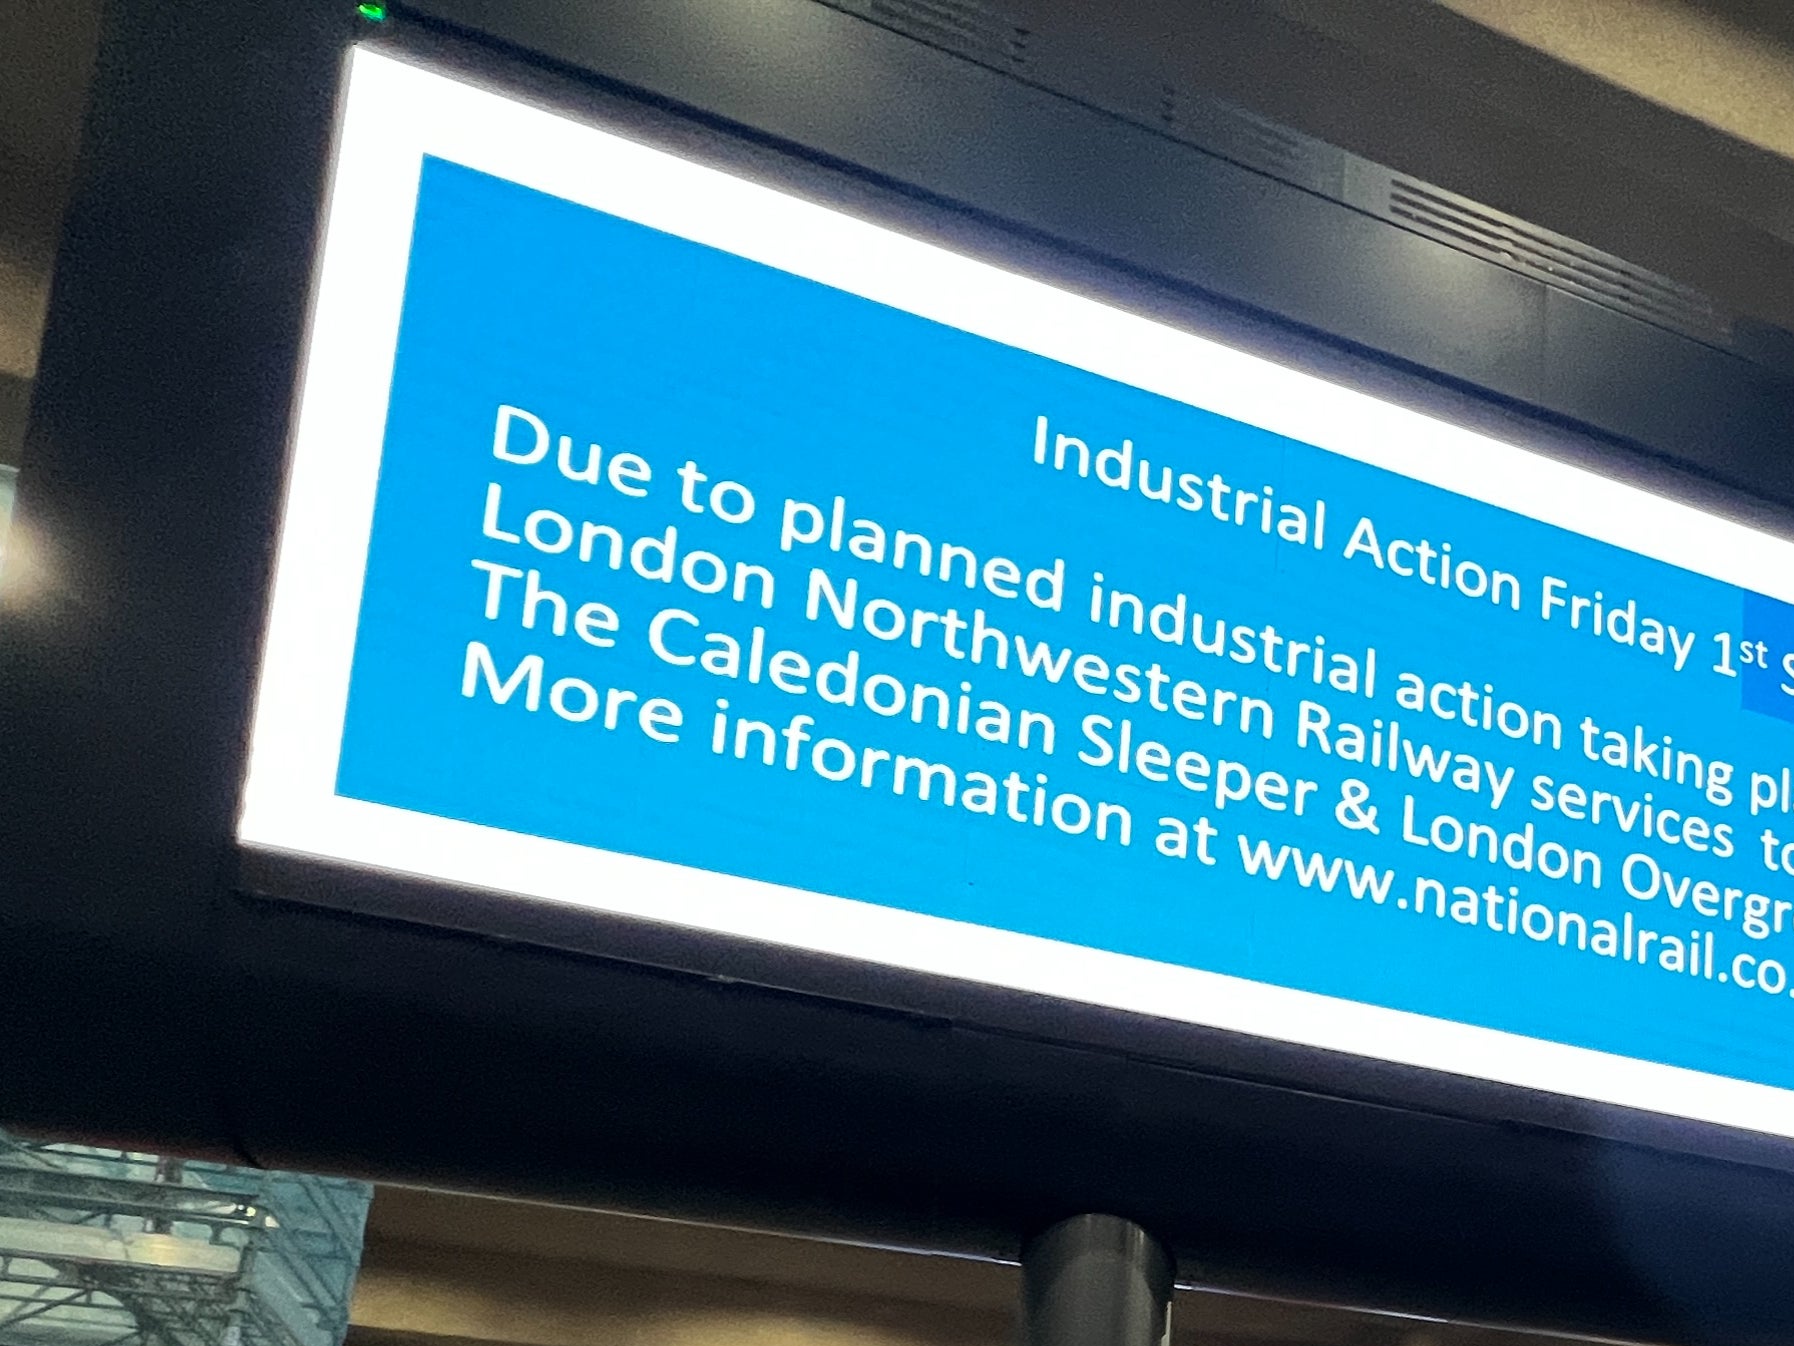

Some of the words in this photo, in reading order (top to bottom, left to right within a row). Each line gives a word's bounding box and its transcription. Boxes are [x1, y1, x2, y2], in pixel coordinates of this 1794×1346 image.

[482, 482, 775, 609] London
[806, 568, 1274, 739] Northwestern
[1297, 700, 1515, 810] Railway
[1531, 775, 1734, 858] services
[493, 404, 652, 497] Due
[677, 460, 755, 524] to
[780, 494, 1065, 612] planned
[1090, 572, 1376, 698] industrial
[1396, 672, 1562, 750] action
[1579, 716, 1734, 807] taking
[1034, 415, 1326, 550] Industrial
[1343, 517, 1520, 610] Action
[1541, 575, 1695, 672] Friday
[1713, 632, 1768, 678] 1st
[461, 641, 683, 743] More
[712, 698, 1132, 846] information
[1155, 816, 1218, 866] at
[471, 559, 619, 648] The
[648, 608, 1055, 755] Caledonian
[1078, 714, 1318, 816] Sleeper
[1335, 778, 1380, 835] &
[1402, 794, 1602, 889] London
